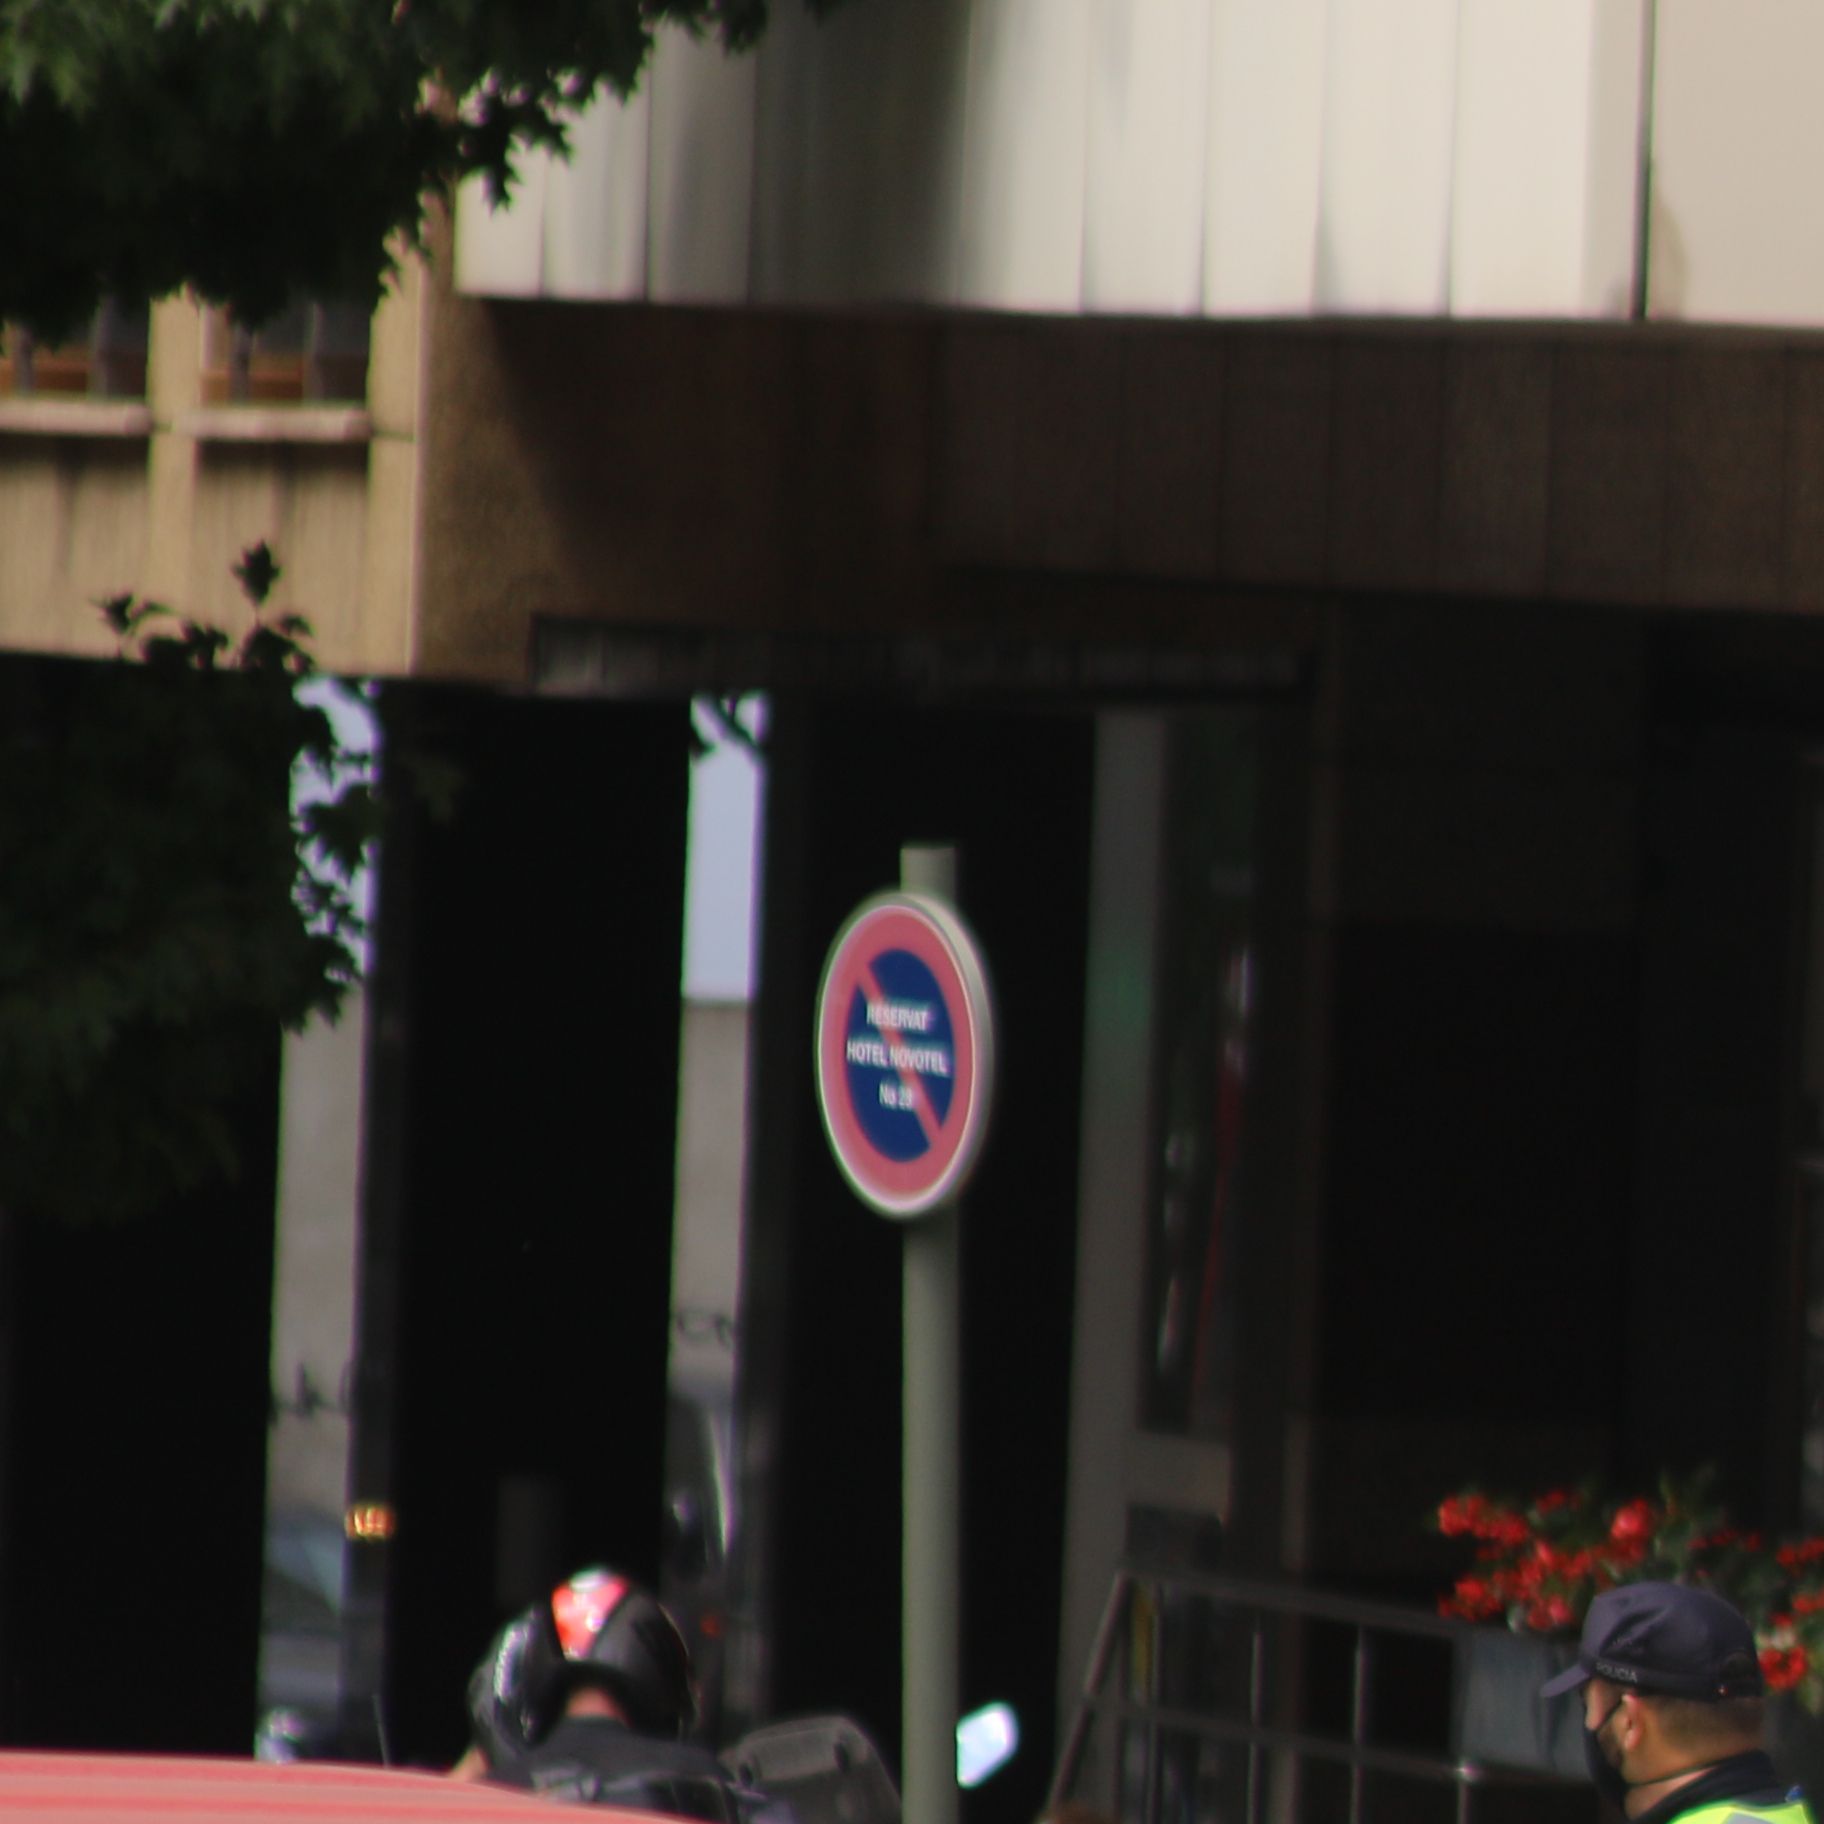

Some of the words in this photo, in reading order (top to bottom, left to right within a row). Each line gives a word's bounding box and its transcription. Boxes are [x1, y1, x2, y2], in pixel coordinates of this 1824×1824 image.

[867, 1001, 930, 1031] RESERVAT
[846, 1040, 890, 1070] HOTEL
[890, 1048, 949, 1077] NOVOTEL
[1595, 1662, 1638, 1684] POLICIA
